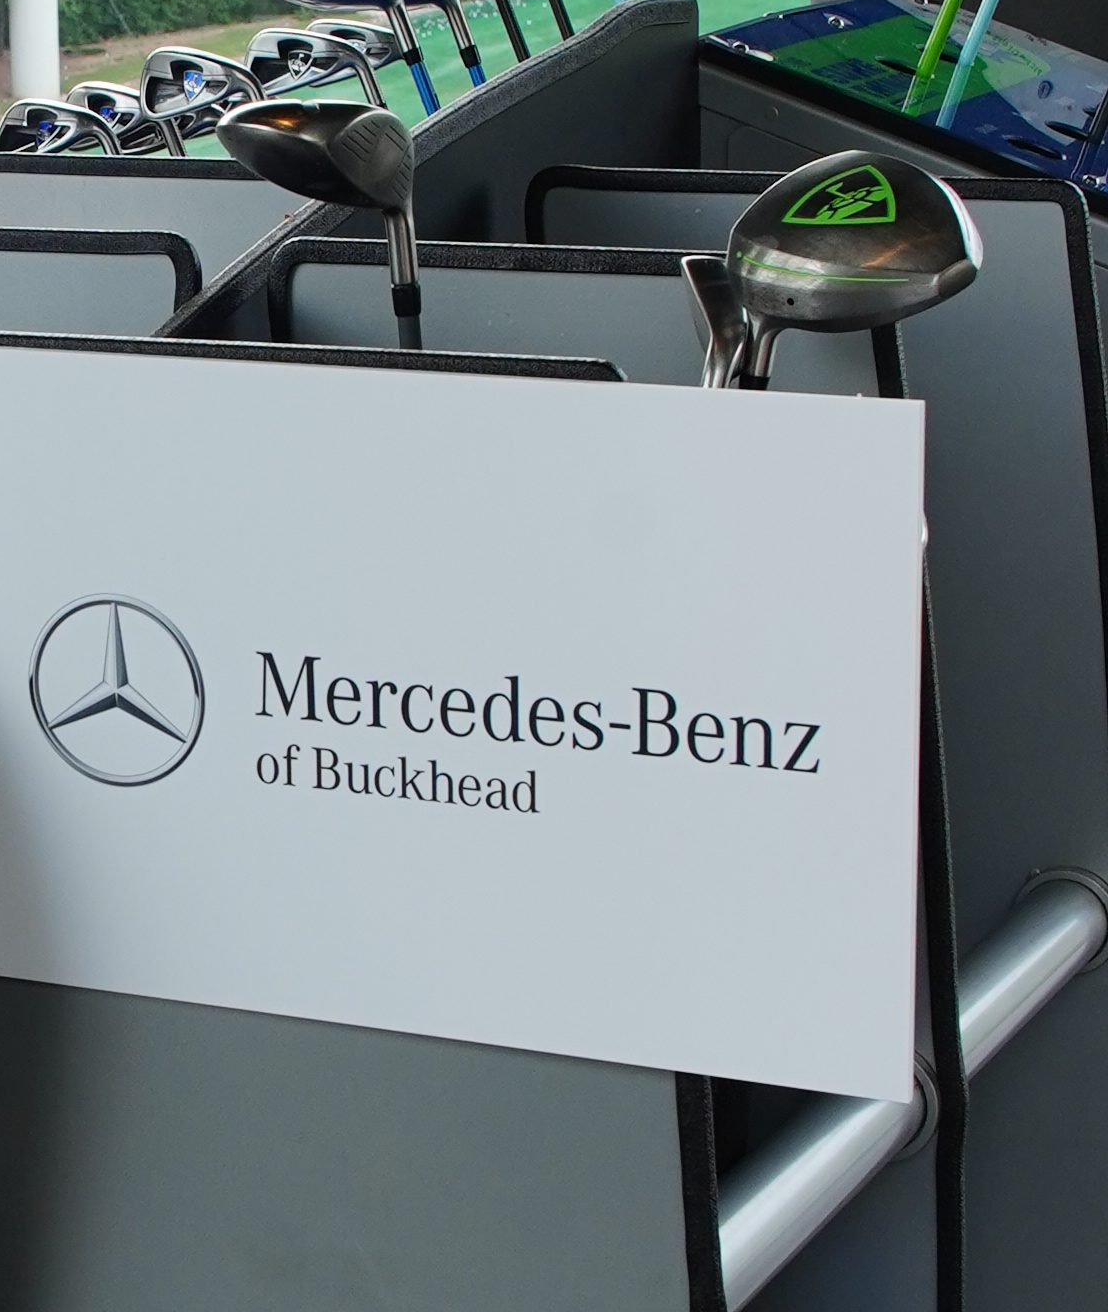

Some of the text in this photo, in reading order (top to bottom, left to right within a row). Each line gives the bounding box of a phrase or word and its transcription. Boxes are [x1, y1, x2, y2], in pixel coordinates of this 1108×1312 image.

[254, 650, 822, 775] Mercedes-Benz
[255, 743, 541, 814] of Buckhead
